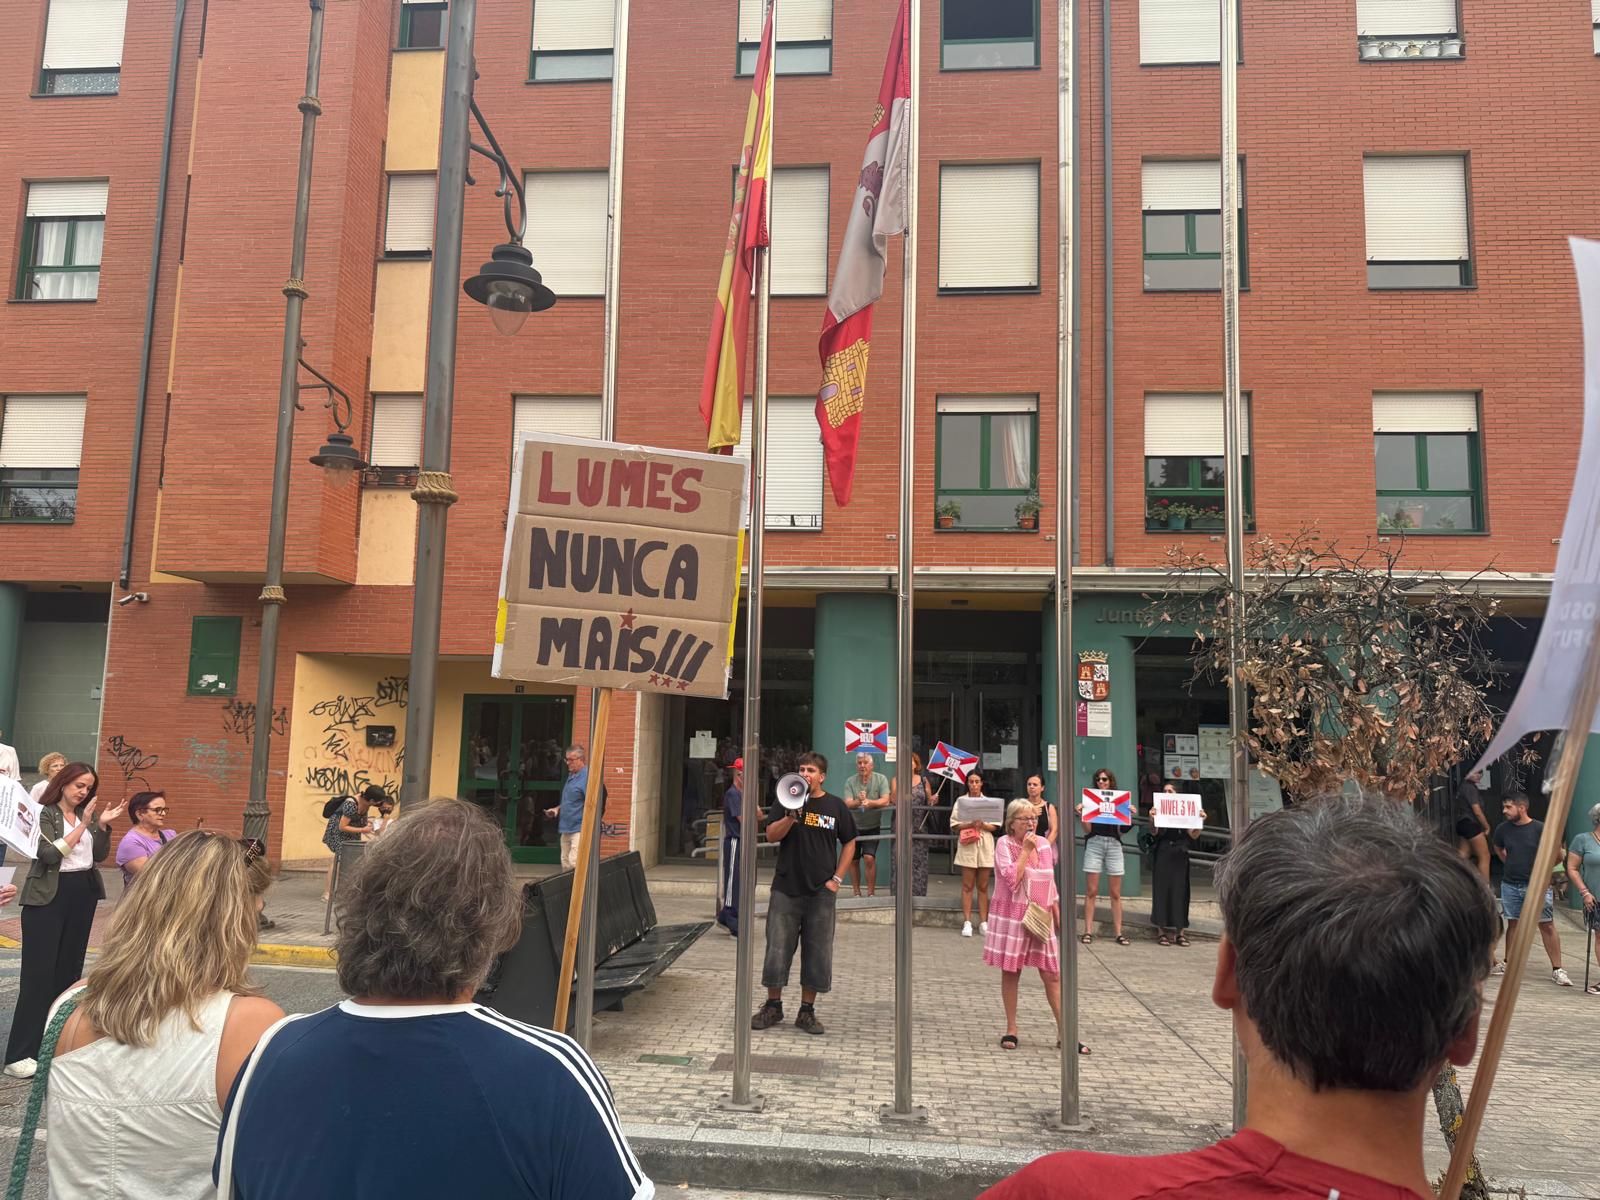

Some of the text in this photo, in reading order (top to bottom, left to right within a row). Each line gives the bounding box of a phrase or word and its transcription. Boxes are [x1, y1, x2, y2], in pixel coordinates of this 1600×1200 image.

[537, 451, 704, 514] LUMES
[528, 527, 699, 601] NUNCA
[1160, 799, 1179, 816] NIVEL
[1180, 799, 1186, 817] 3
